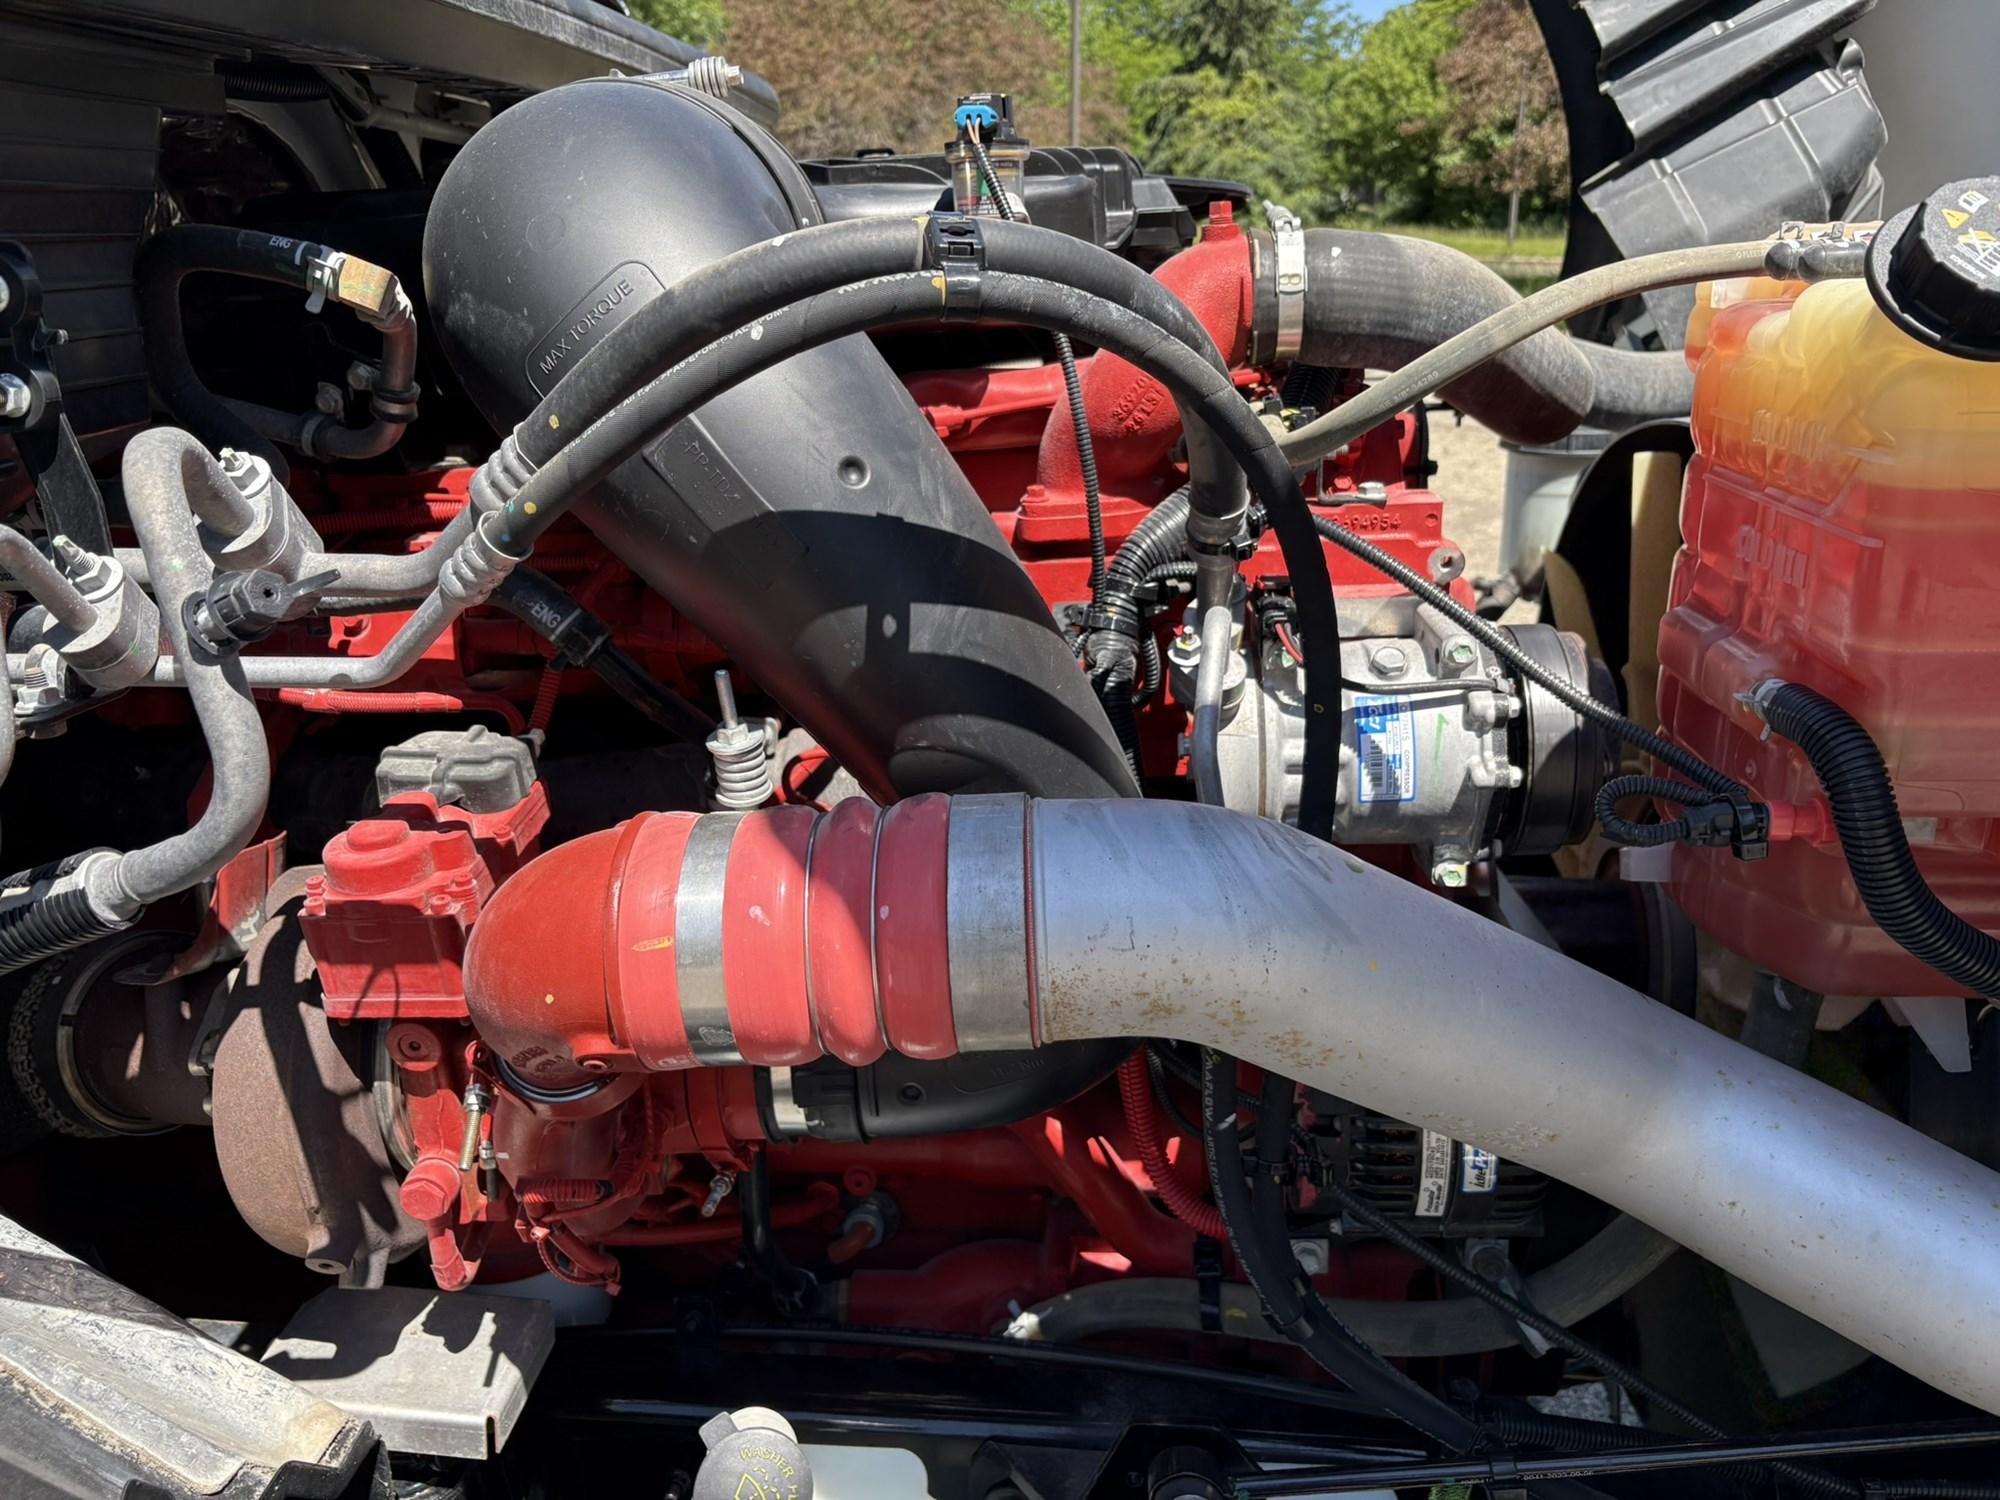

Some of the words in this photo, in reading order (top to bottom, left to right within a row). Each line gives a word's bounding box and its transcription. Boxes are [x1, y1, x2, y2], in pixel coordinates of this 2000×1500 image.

[269, 235, 293, 249] ENG
[538, 338, 572, 375] MAX
[568, 279, 634, 341] TORQUE
[531, 600, 561, 628] ENG
[1203, 1055, 1214, 1121] MAFLOW
[739, 1445, 796, 1480] WASHER
